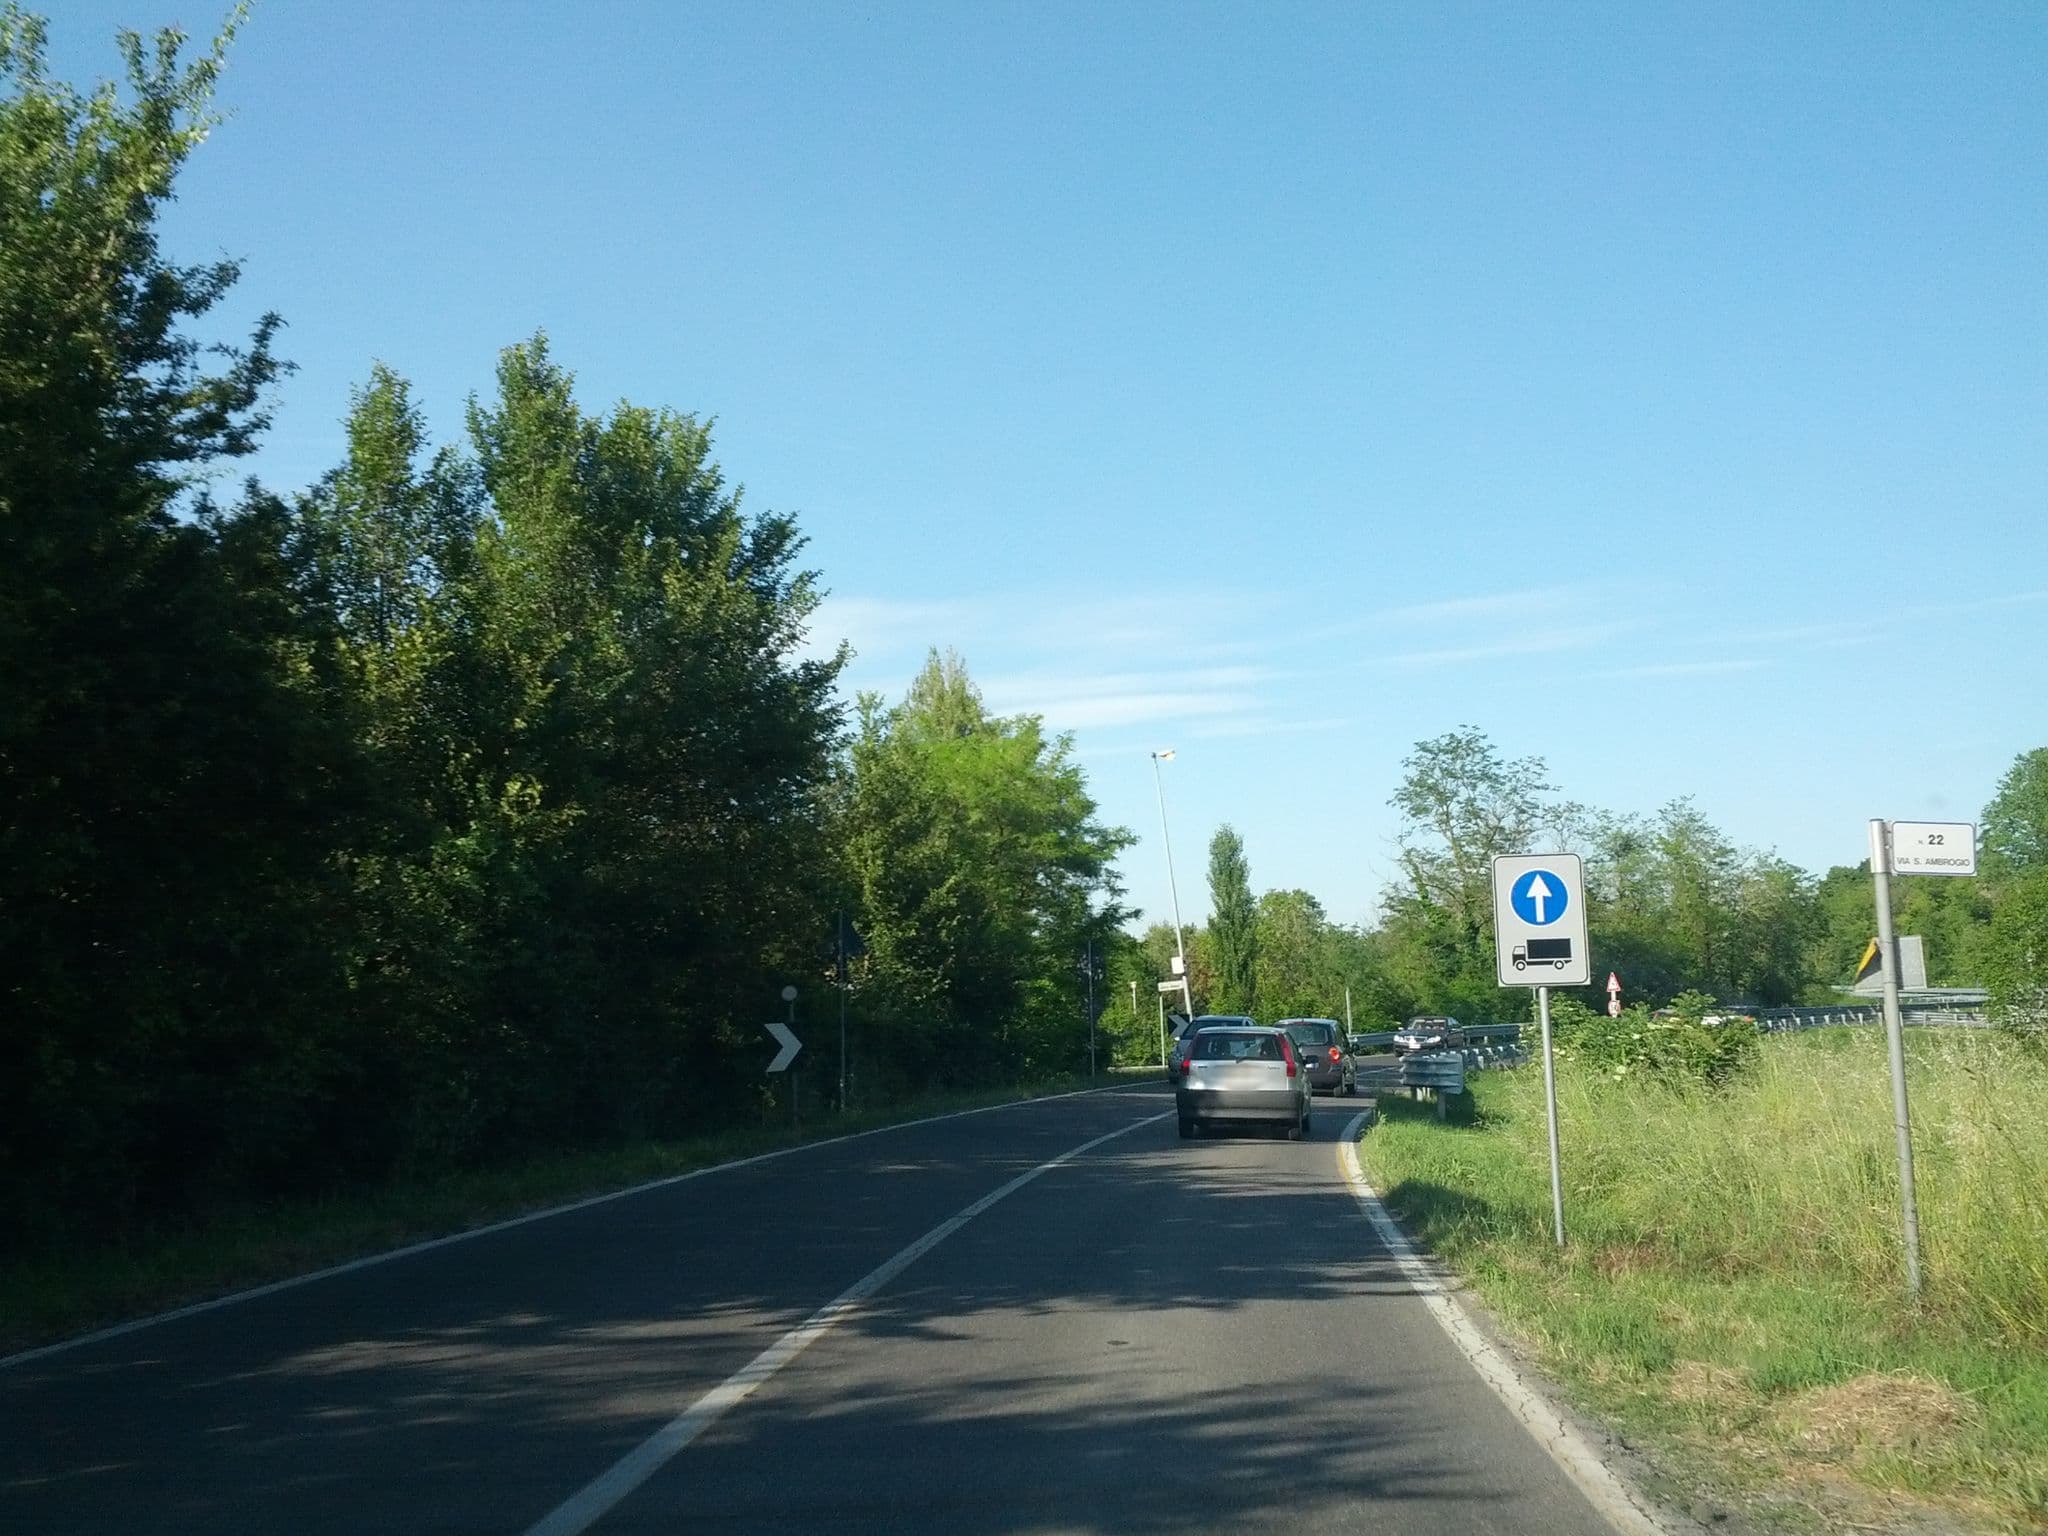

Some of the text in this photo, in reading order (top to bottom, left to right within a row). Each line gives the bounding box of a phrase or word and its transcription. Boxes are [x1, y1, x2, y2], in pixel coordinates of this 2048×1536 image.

[1928, 834, 1944, 845] 22
[1896, 857, 1970, 866] VIA S. AMBROGIO
